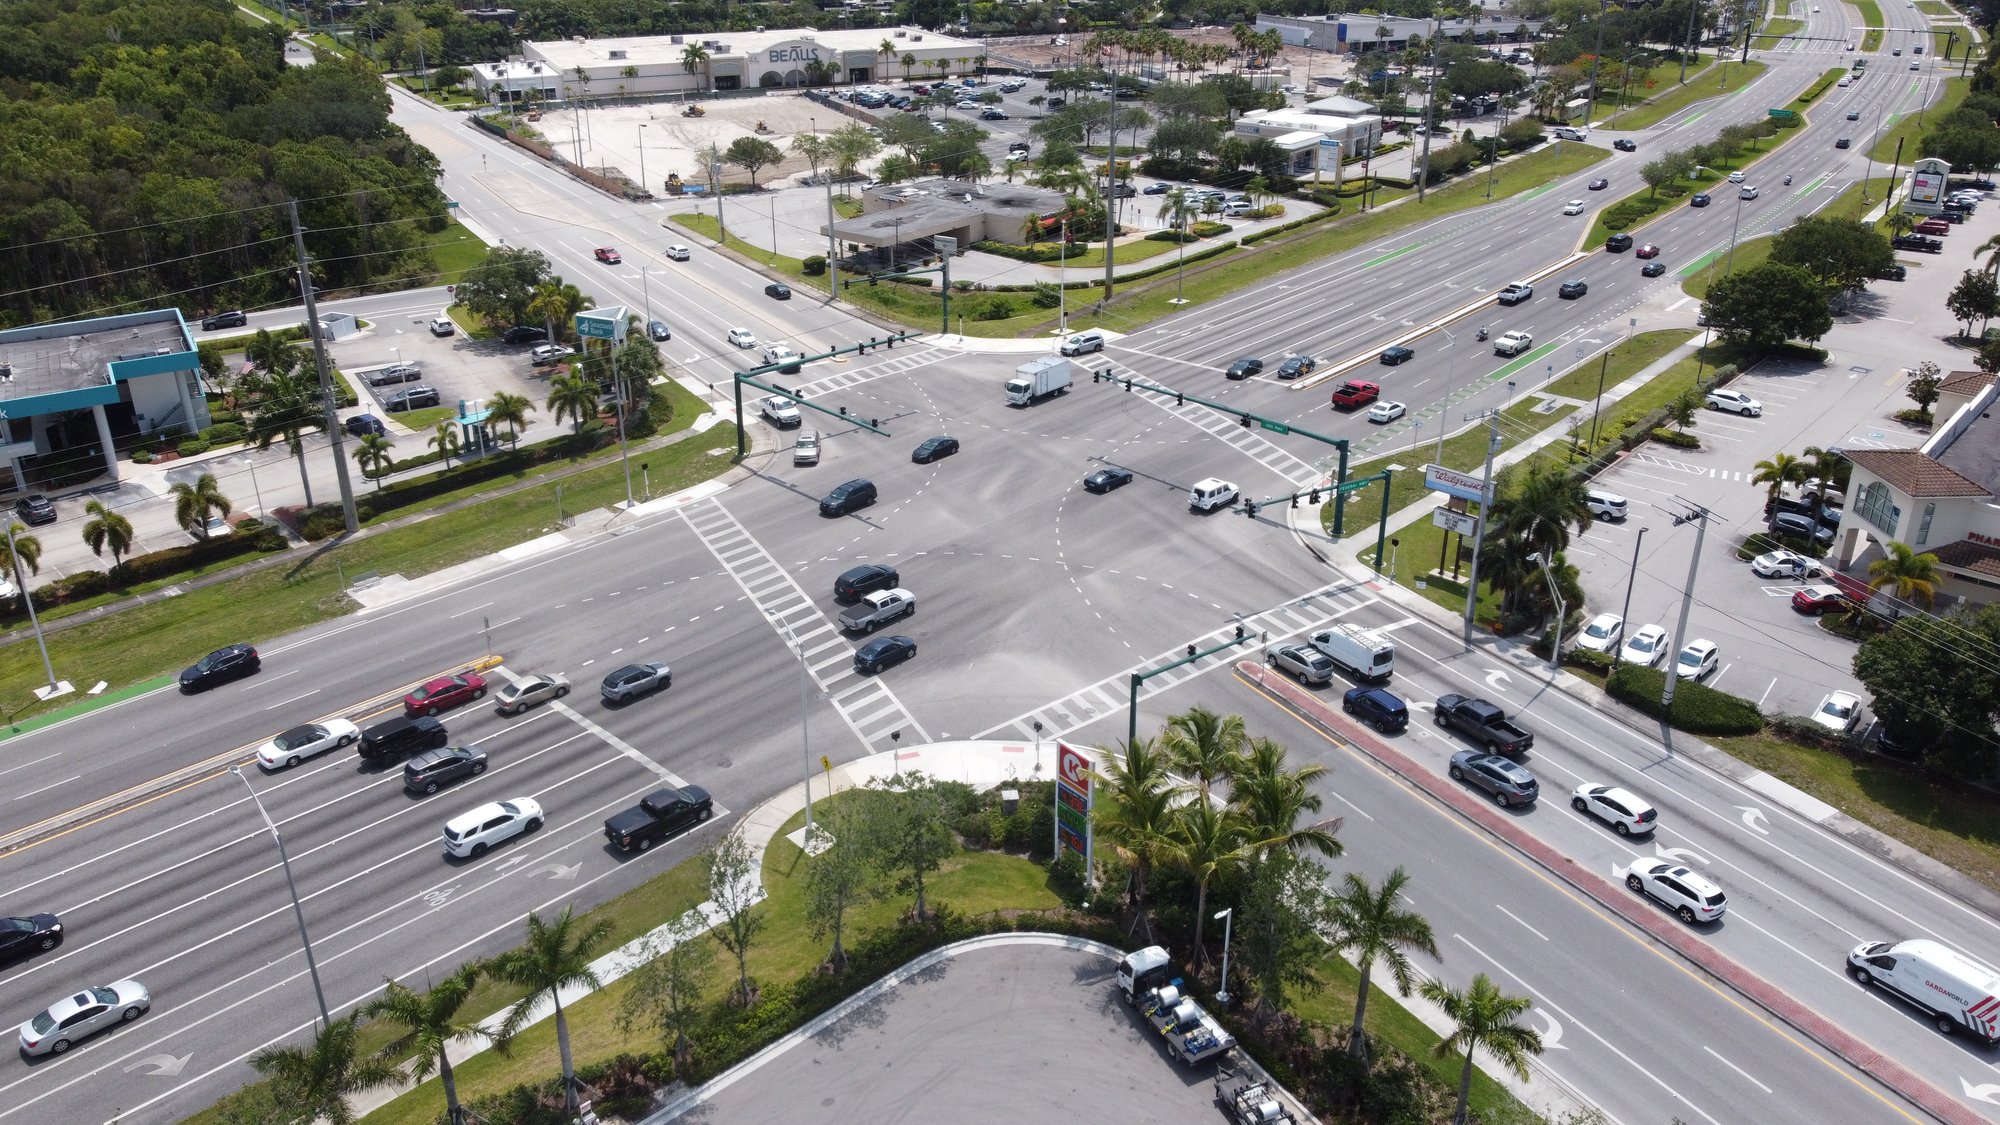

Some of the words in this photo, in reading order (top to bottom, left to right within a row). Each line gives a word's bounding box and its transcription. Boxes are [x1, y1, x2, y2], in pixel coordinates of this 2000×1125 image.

[769, 46, 818, 62] BEALLS
[589, 320, 613, 330] Seacoast
[590, 327, 604, 335] Bank
[1339, 483, 1358, 491] FEDERAL
[1434, 470, 1484, 492] Walgreens
[1924, 980, 1969, 1006] GARDAWORLD
